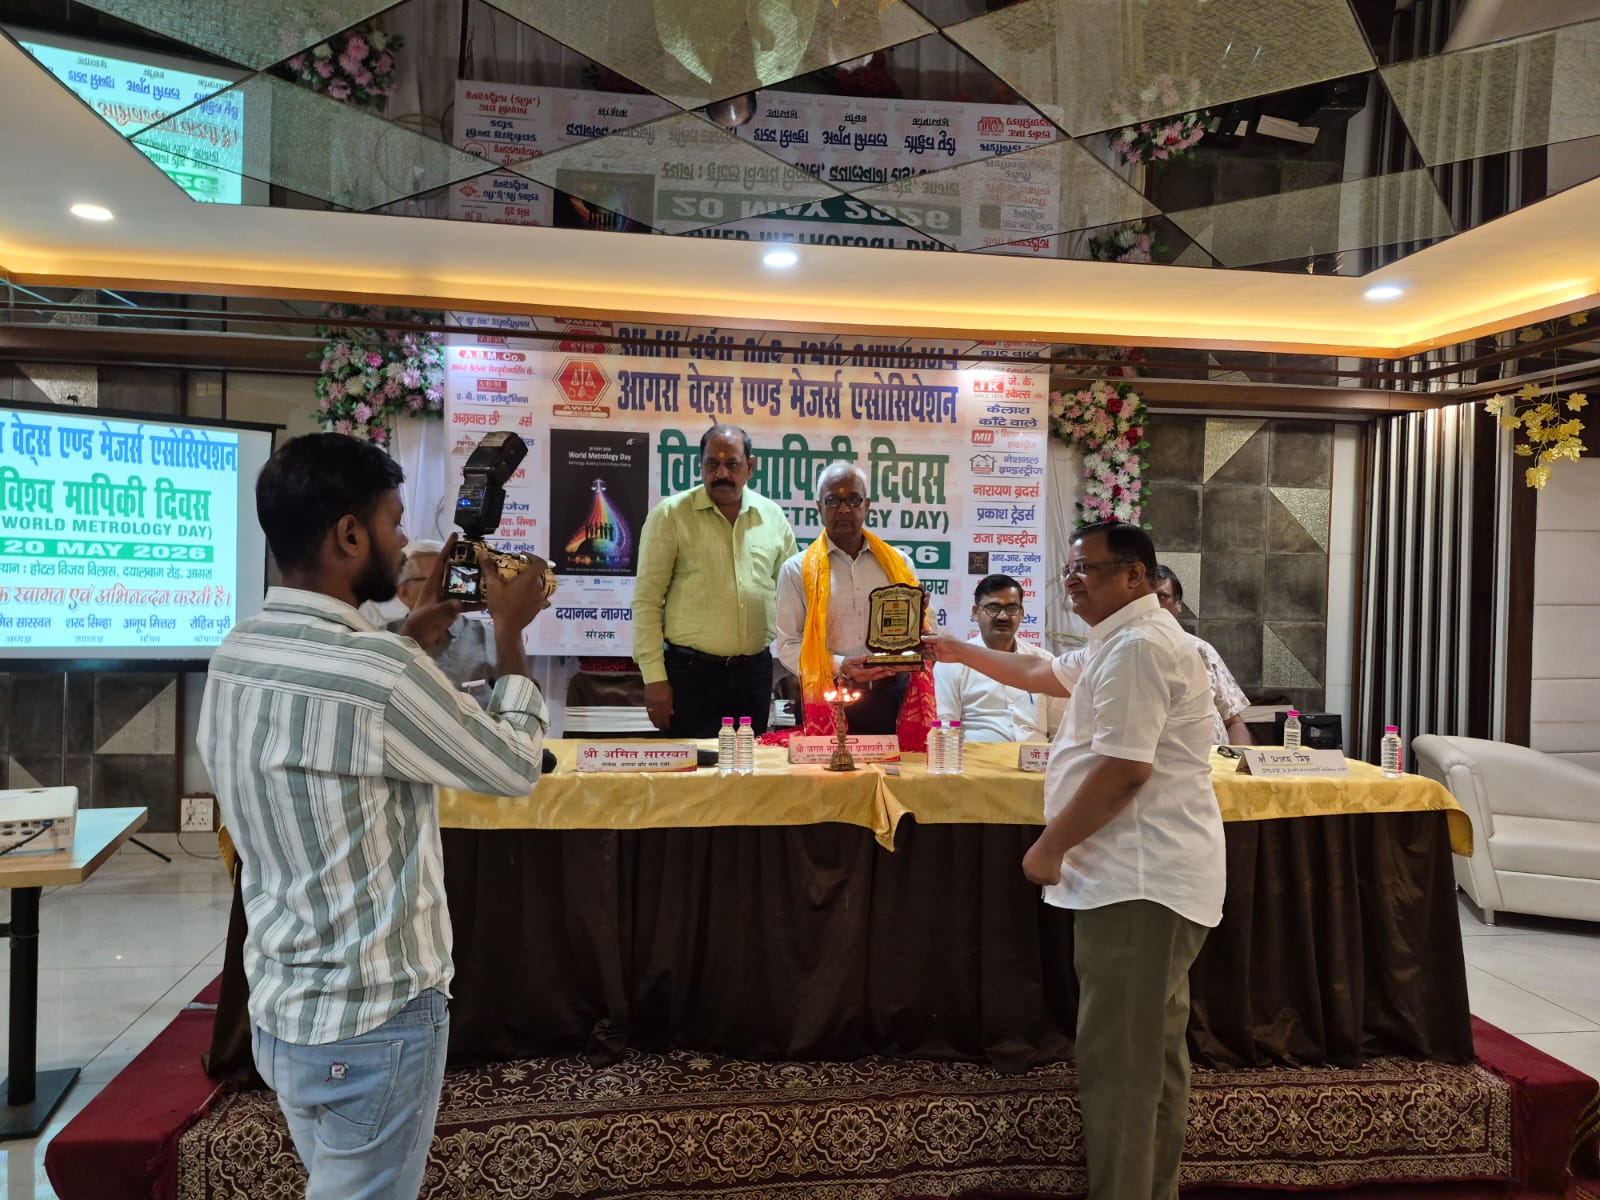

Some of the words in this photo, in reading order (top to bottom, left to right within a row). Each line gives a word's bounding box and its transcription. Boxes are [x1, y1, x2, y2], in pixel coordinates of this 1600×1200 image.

[617, 369, 681, 413] आगरा
[687, 362, 734, 426] वेट्स
[740, 376, 783, 417] एण्ड
[789, 367, 843, 419] मेजर्स
[849, 371, 959, 424] एसोसियेशन
[11, 411, 52, 466] वेट्स
[57, 426, 94, 460] एण्ड
[98, 420, 144, 465] मेजर्स
[149, 427, 238, 472] एसोसियेशन
[867, 436, 950, 505] दिवस
[0, 465, 56, 514] विश्व
[62, 472, 147, 519] मापिकी
[153, 476, 212, 522] दिवस
[973, 484, 1013, 497] नारायण
[900, 509, 950, 535] DAY)
[976, 507, 1009, 521] प्रकाश
[72, 518, 172, 537] METROLOGY
[178, 524, 214, 541] DAY)
[973, 533, 994, 544] राजा
[4, 539, 45, 555] 20
[57, 541, 124, 557] MAY
[132, 544, 207, 561] 2026
[30, 559, 55, 576] होटल
[58, 559, 85, 577] विजय
[122, 566, 164, 579] दयालबाग
[14, 586, 65, 605] स्वागत
[95, 581, 171, 607] अभिनन्दन
[16, 616, 52, 629] सारस्वत
[65, 616, 85, 629] शरद
[190, 614, 214, 630] रोहित
[555, 607, 598, 620] दयानन्द
[601, 607, 633, 621] नागरा
[123, 617, 147, 634] अनूप
[585, 628, 616, 641] संरक्षक
[583, 747, 598, 759] श्री
[604, 747, 639, 760] अमित
[643, 750, 689, 759] सारस्वत
